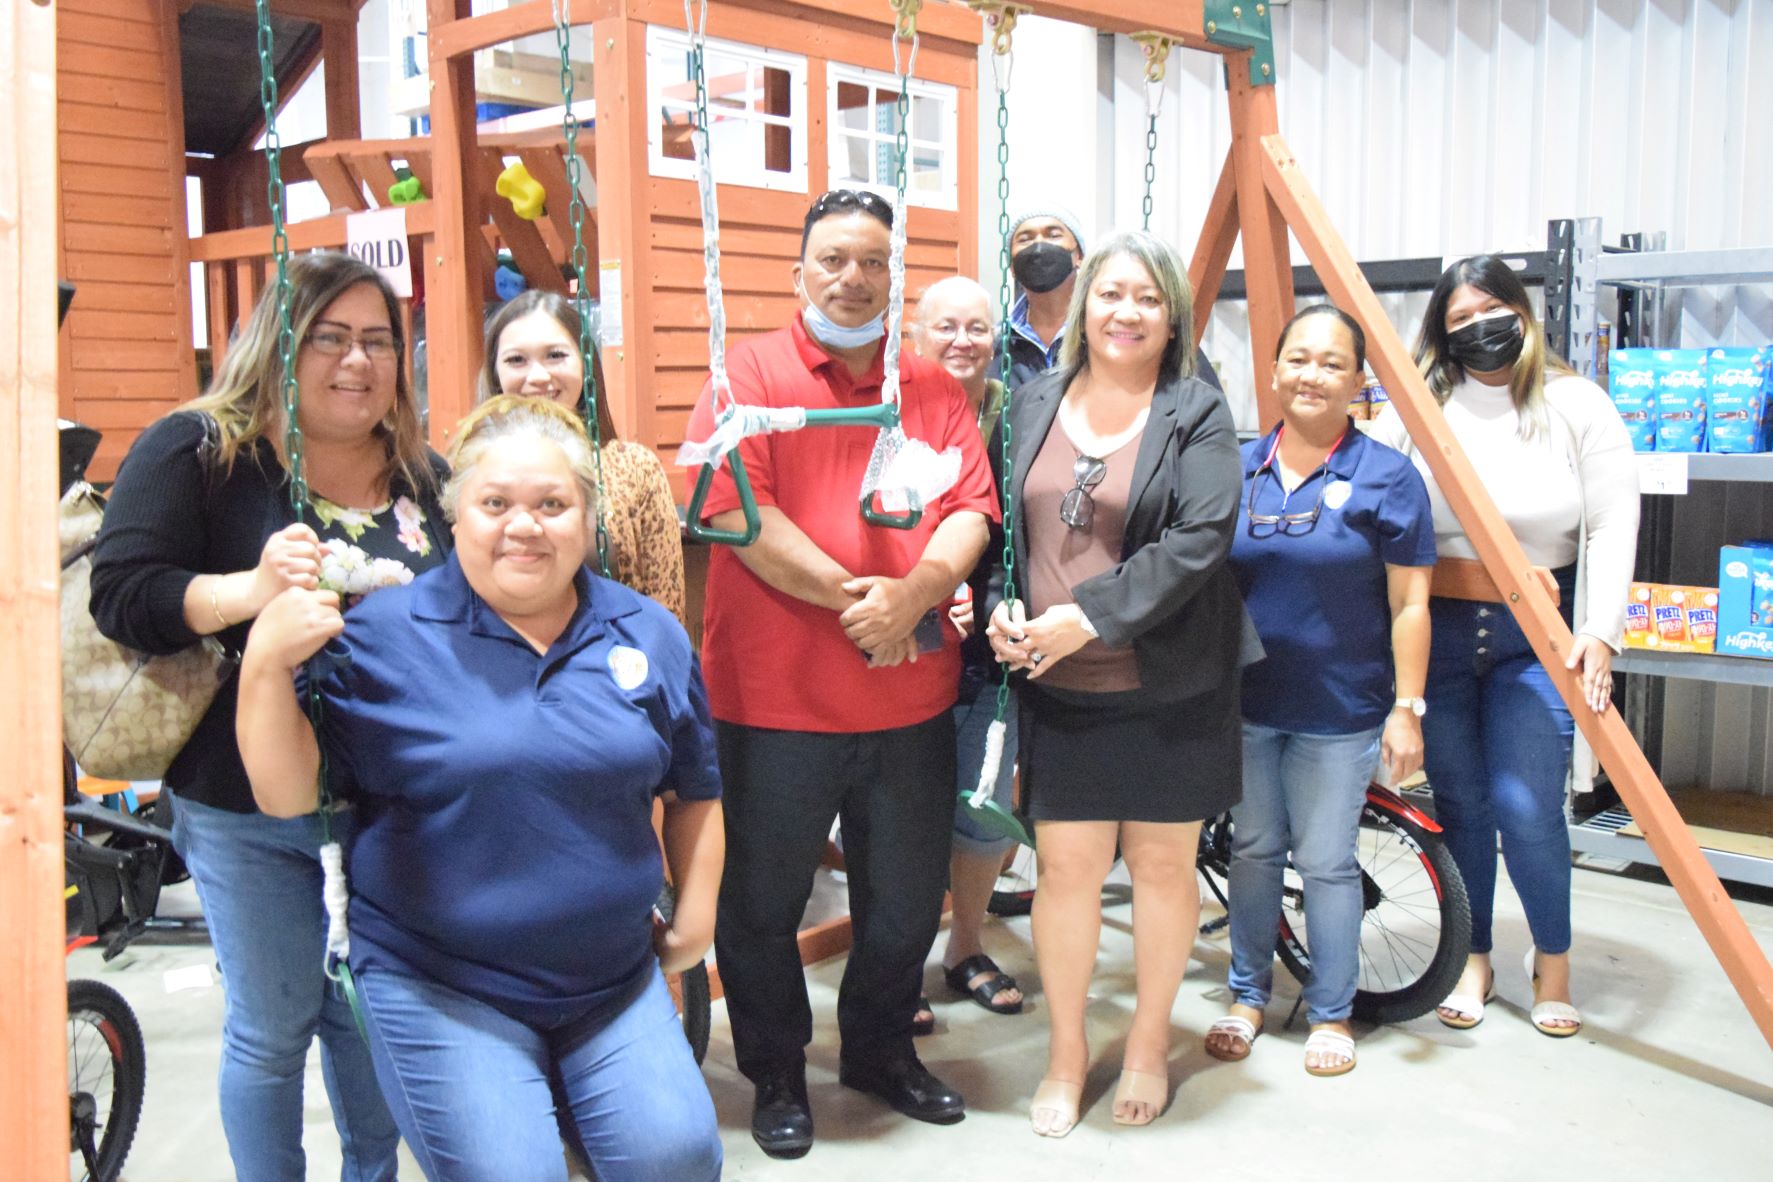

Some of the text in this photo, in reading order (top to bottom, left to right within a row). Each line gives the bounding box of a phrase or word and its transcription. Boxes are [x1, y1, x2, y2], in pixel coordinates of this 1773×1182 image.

[351, 239, 404, 268] SOLD
[1627, 605, 1647, 617] RETZ
[1655, 607, 1681, 620] PRETZ
[1688, 610, 1714, 623] PRETZ
[1724, 631, 1773, 652] Highke
